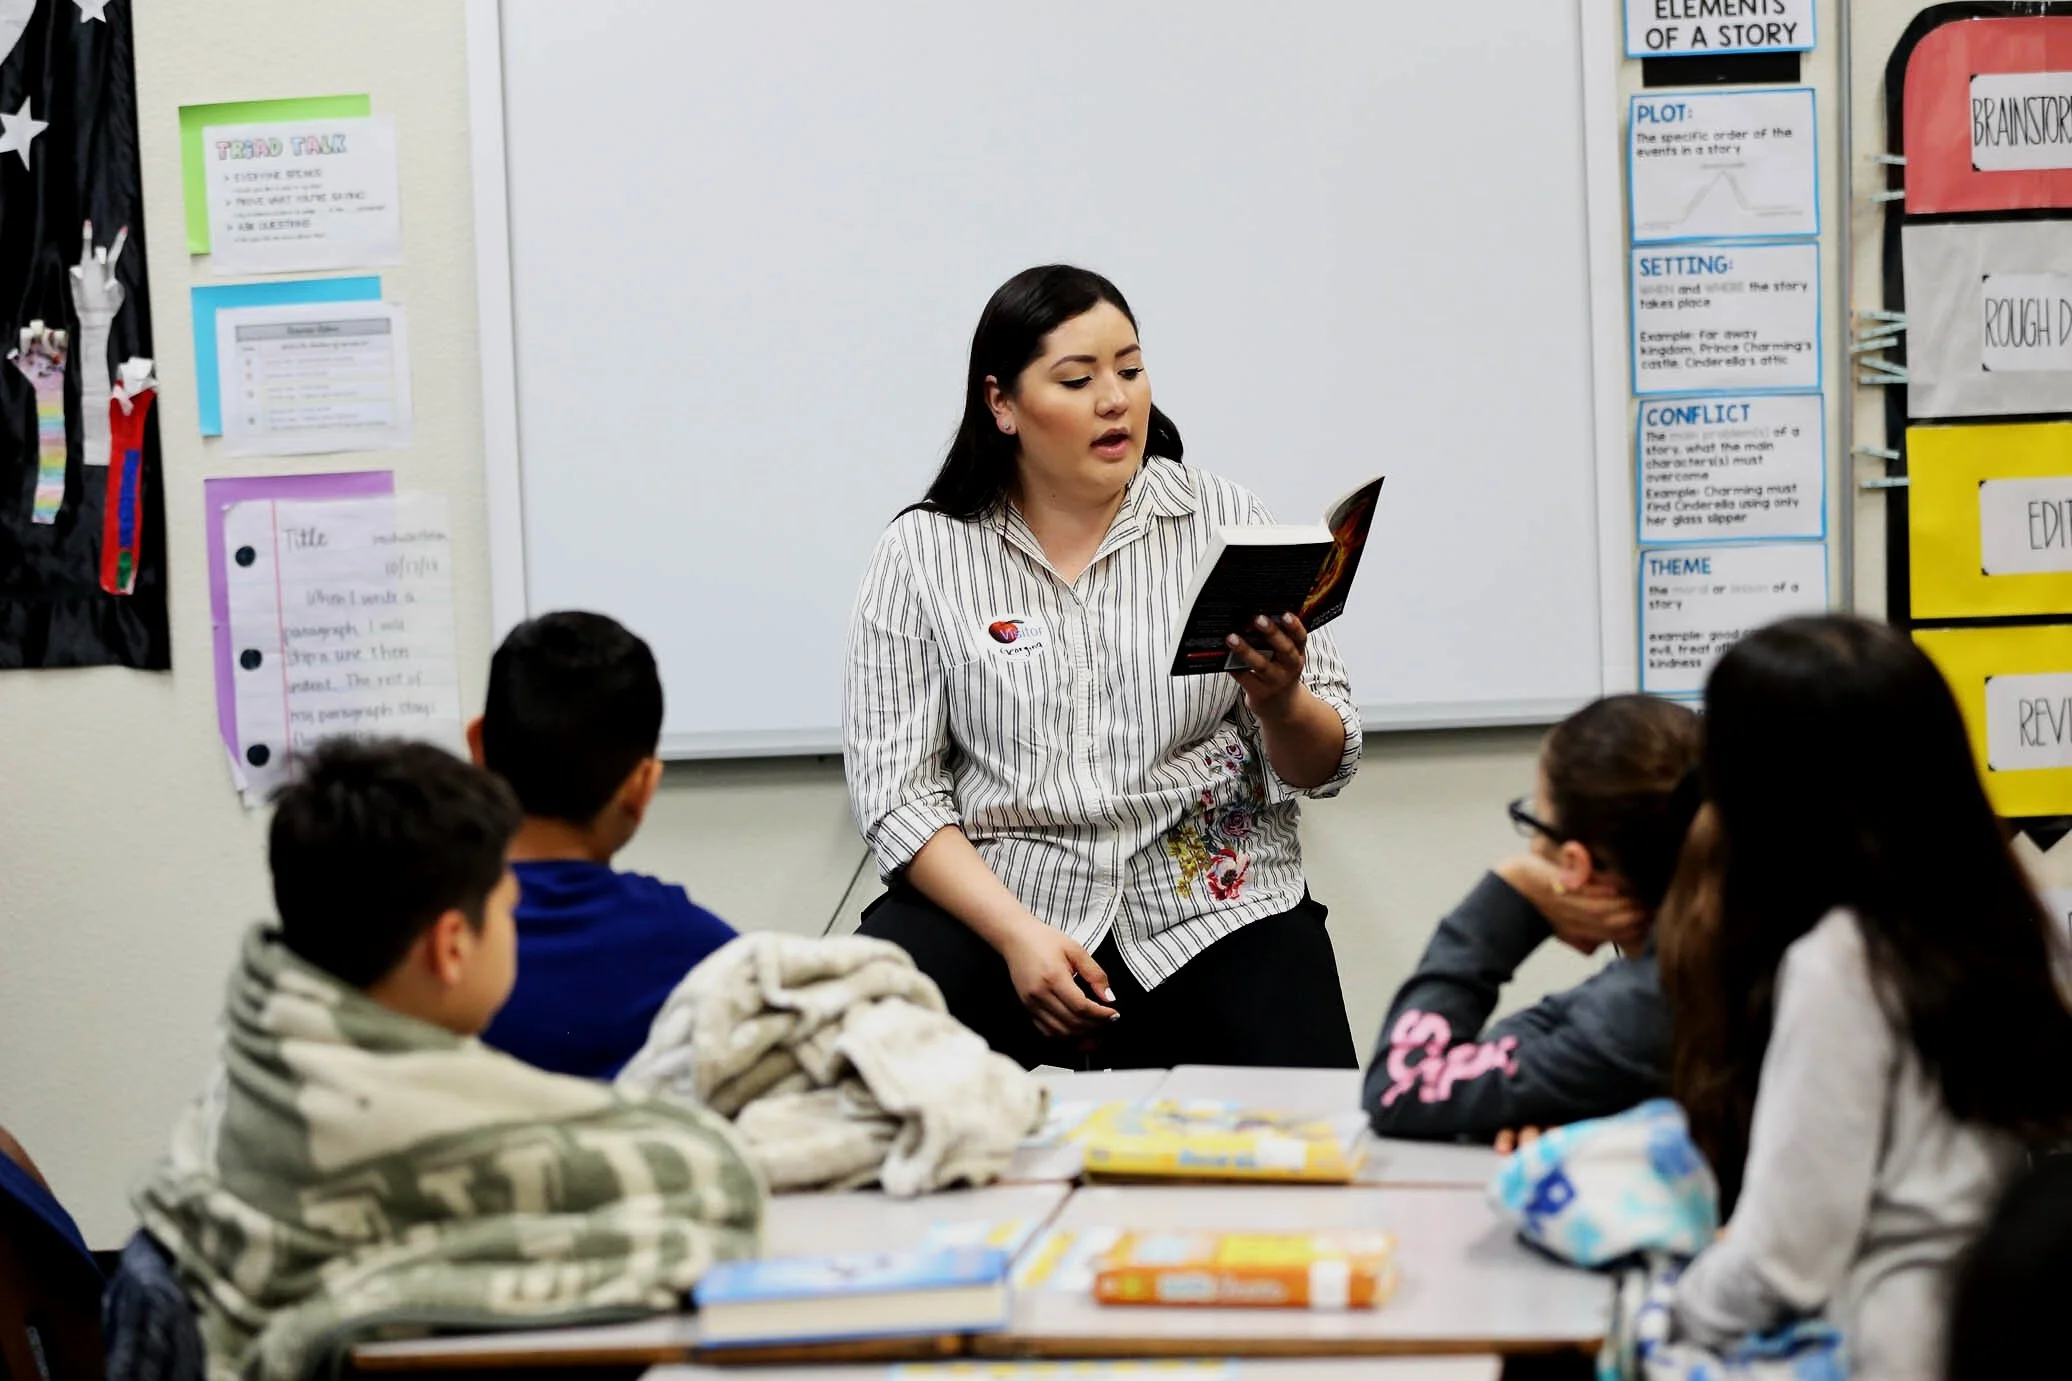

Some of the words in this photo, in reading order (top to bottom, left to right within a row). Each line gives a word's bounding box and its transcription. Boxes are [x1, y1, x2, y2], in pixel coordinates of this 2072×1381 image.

[1655, 0, 1785, 19] ELEMENTS
[1646, 27, 1679, 49] OF
[1692, 26, 1707, 47] A
[1719, 22, 1797, 46] STORY
[1637, 104, 1693, 124] PLOT:
[1972, 96, 2072, 147] BRAINSTOR
[1637, 133, 1655, 144] The
[1661, 130, 1708, 145] specific
[1714, 129, 1747, 141] order
[1753, 128, 1767, 139] of
[1773, 127, 1792, 138] the
[290, 134, 347, 156] TALK
[1637, 145, 1677, 157] events
[1681, 144, 1692, 155] in
[1696, 145, 1703, 155] a
[1708, 143, 1740, 156] story
[1639, 256, 1734, 277] SETTING:
[1678, 284, 1700, 295] and
[1750, 281, 1769, 291] the
[1774, 281, 1808, 293] story
[1640, 299, 1674, 310] takes
[1678, 298, 1710, 311] place
[1985, 298, 2050, 347] ROUGH
[1724, 329, 1757, 341] away
[1700, 343, 1739, 353] Prince
[1760, 355, 1788, 366] attic
[1647, 404, 1750, 426] CONFLICT
[1647, 432, 1664, 442] The
[1773, 427, 1787, 437] of
[1792, 428, 1800, 438] a
[1685, 443, 1715, 454] what
[1721, 442, 1740, 452] the
[1744, 441, 1773, 452] main
[1733, 456, 1763, 466] must
[1646, 471, 1709, 483] overcome
[1704, 485, 1763, 498] Charming
[1766, 484, 1798, 495] must
[1675, 500, 1735, 512] Cinderella
[1739, 498, 1770, 510] using
[1774, 497, 1799, 509] only
[1647, 515, 1665, 526] her
[1673, 513, 1702, 527] glass
[1707, 513, 1748, 526] slipper
[285, 527, 328, 553] Title
[1650, 557, 1712, 576] THEME
[1649, 585, 1668, 595] the
[1713, 585, 1726, 594] or
[1772, 582, 1786, 593] of
[1791, 583, 1800, 593] a
[1649, 599, 1682, 611] story
[1000, 626, 1042, 641] Visitor
[1709, 629, 1739, 642] good
[1678, 643, 1710, 655] treat
[1649, 658, 1702, 669] kindness
